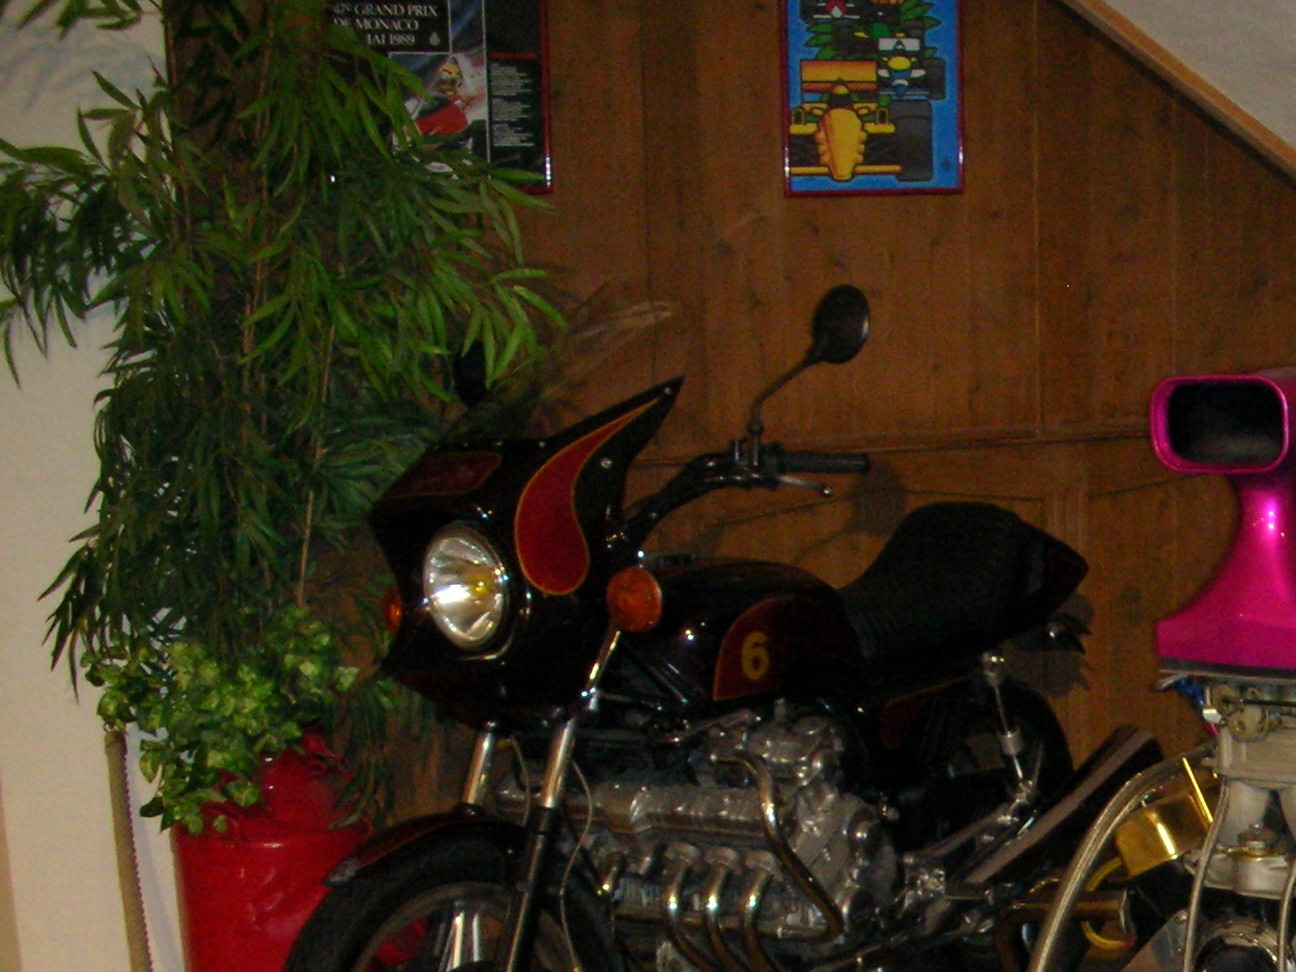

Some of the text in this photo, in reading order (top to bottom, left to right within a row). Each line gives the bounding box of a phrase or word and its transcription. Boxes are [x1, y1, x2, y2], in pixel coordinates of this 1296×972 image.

[353, 4, 405, 16] GRAND
[407, 4, 438, 17] PRIX
[354, 18, 420, 31] MONACO
[740, 630, 771, 681] 6
